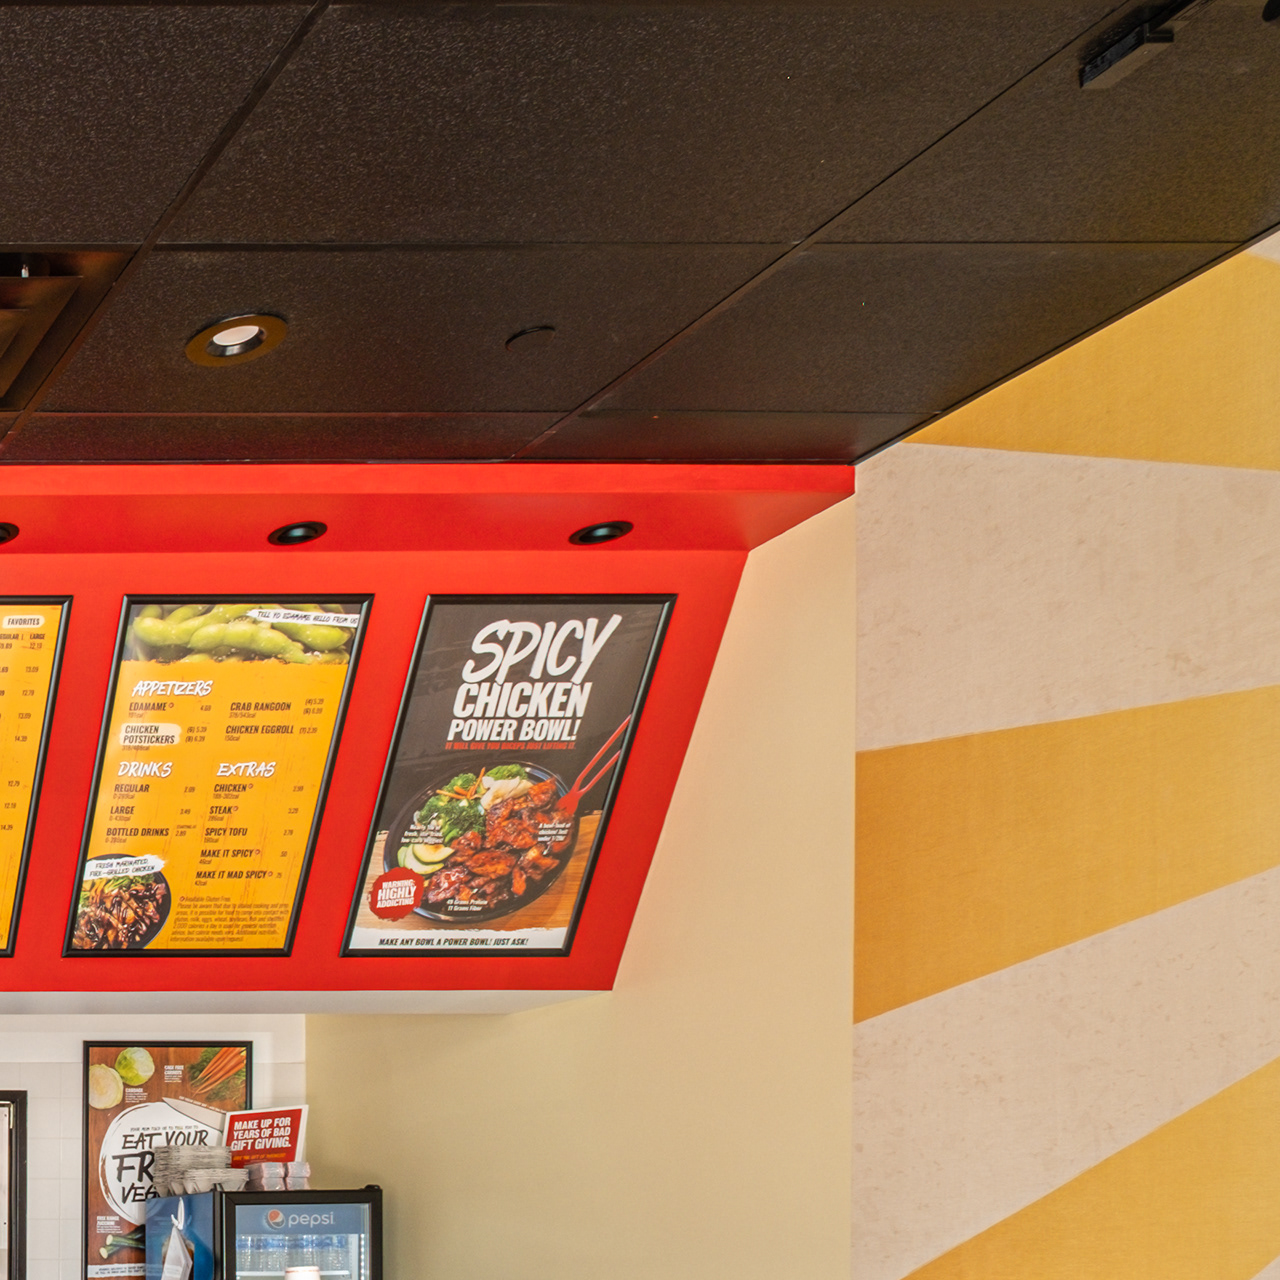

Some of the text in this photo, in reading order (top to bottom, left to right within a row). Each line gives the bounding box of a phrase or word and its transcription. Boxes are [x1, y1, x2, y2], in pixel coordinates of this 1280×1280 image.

[461, 613, 623, 685] SPICY
[131, 680, 214, 697] APPETIZERS
[452, 681, 593, 718] CHICKEN
[129, 702, 292, 711] EDAMAME CRAB RANGOON
[125, 725, 294, 734] CHICKEN CHICKEN EGGROLL
[447, 719, 582, 741] POWER BOWL!
[123, 735, 175, 744] POTSTICKERS
[118, 761, 276, 777] DRINKS EXTRAS
[106, 828, 169, 836] BOTTLED DRINKS
[382, 879, 415, 889] WARNING:
[378, 886, 417, 900] HIGHLY
[376, 898, 415, 908] ADDICTING
[378, 938, 529, 946] MAKE ANY BOWL A POWER BOWL! JUST ASK!
[234, 1117, 291, 1130] MAKE UP FOR
[122, 1130, 209, 1150] EAT YOUR
[233, 1127, 291, 1140] YEARS OF BAD
[231, 1137, 291, 1151] GIFT GIVING.
[288, 1212, 334, 1228] pepsi
